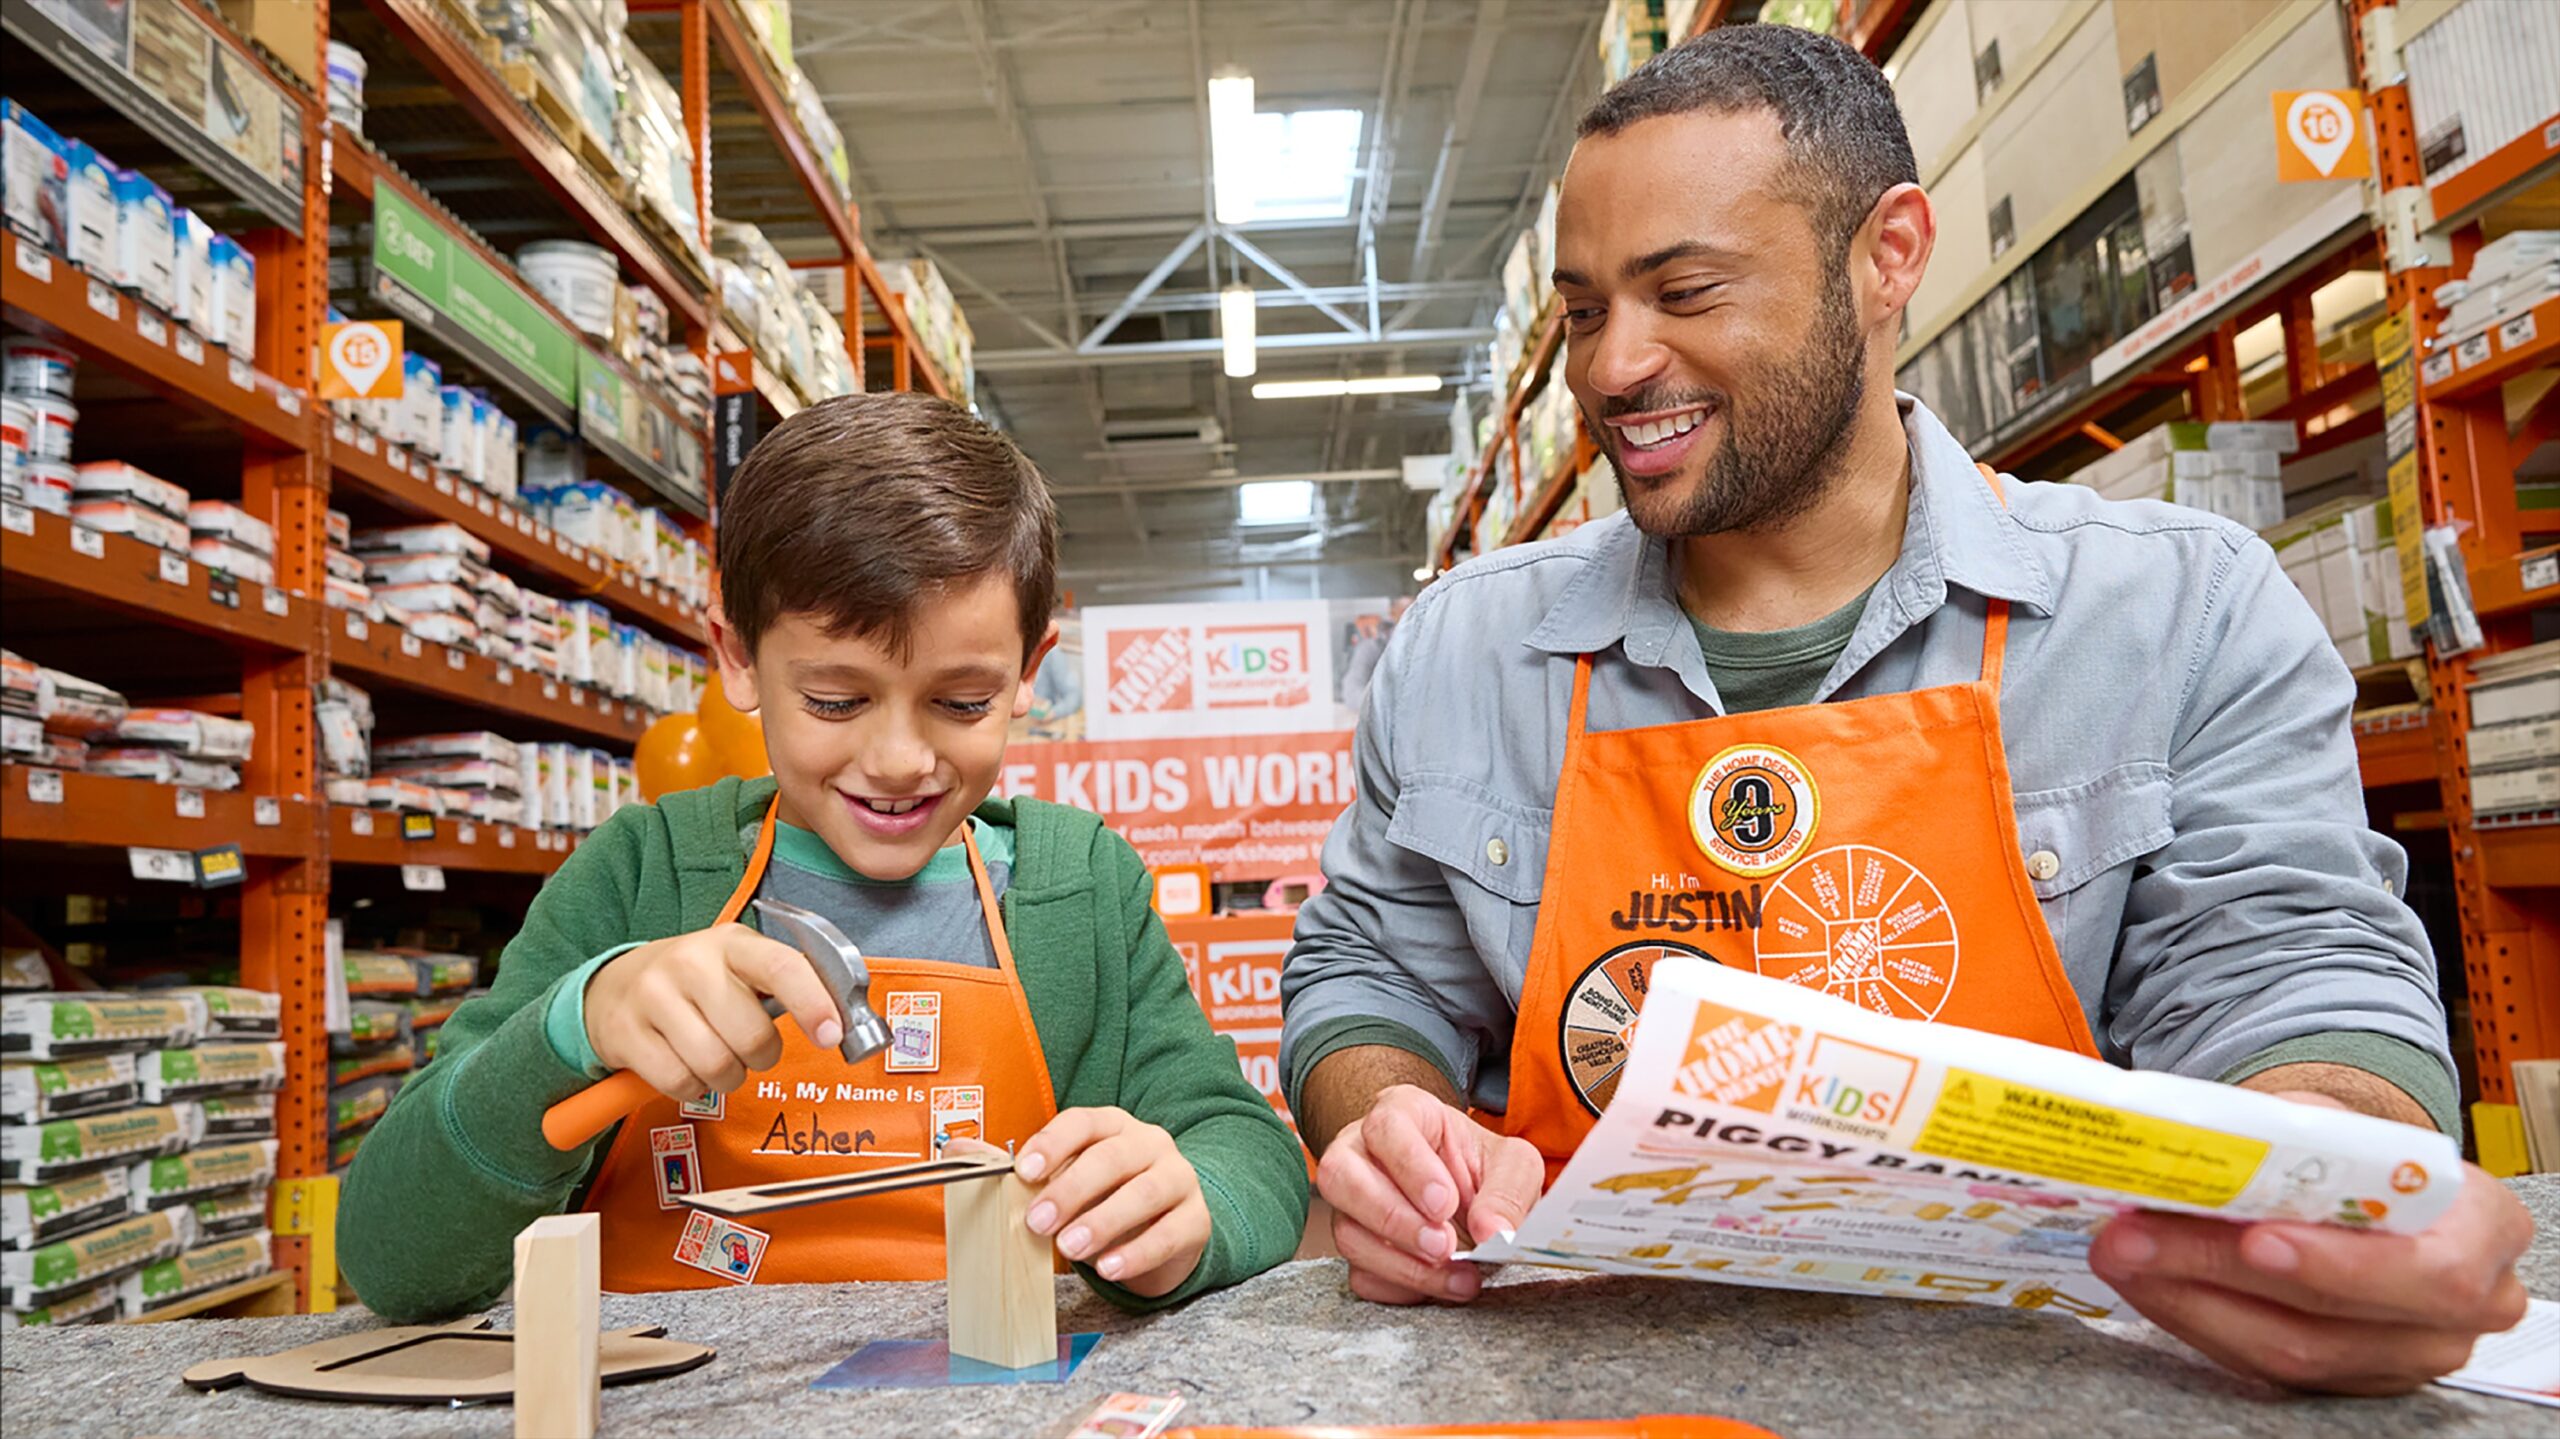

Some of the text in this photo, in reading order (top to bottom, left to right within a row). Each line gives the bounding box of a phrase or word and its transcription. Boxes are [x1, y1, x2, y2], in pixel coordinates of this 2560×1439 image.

[2302, 115, 2338, 138] 16
[1107, 626, 1192, 713] HOME
[1114, 634, 1152, 671] THE
[1206, 643, 1290, 676] KIDS
[1142, 656, 1193, 710] DEPOT
[1055, 758, 1189, 815] KIDS
[1703, 755, 1801, 792] THE HOME DEPOT
[1720, 799, 1785, 831] Years
[1730, 775, 1775, 847] 9
[1709, 828, 1803, 866] SERVICE AWARD
[1651, 873, 1700, 890] Hi, I'm
[1611, 883, 1763, 932] JUSTIN
[1778, 916, 1809, 934] GIVING
[1881, 904, 1946, 944] RELATIONSHIPS
[1779, 925, 1804, 939] BACK
[1831, 921, 1878, 980] HOME
[1833, 927, 1854, 952] THE
[1850, 941, 1879, 978] DEPOT
[1899, 972, 1930, 988] SPIRIT
[1601, 1006, 1627, 1026] THING
[1695, 1015, 1751, 1053] THE
[1676, 1020, 1797, 1098] HOME
[757, 1081, 926, 1103] Hi, My Name Is
[1713, 1058, 1789, 1104] DEPOT
[1795, 1073, 1891, 1123] KIDS
[760, 1112, 876, 1155] Asher
[1654, 1108, 1859, 1158] PIGGY
[1785, 1106, 1889, 1143] WORKSHOPS
